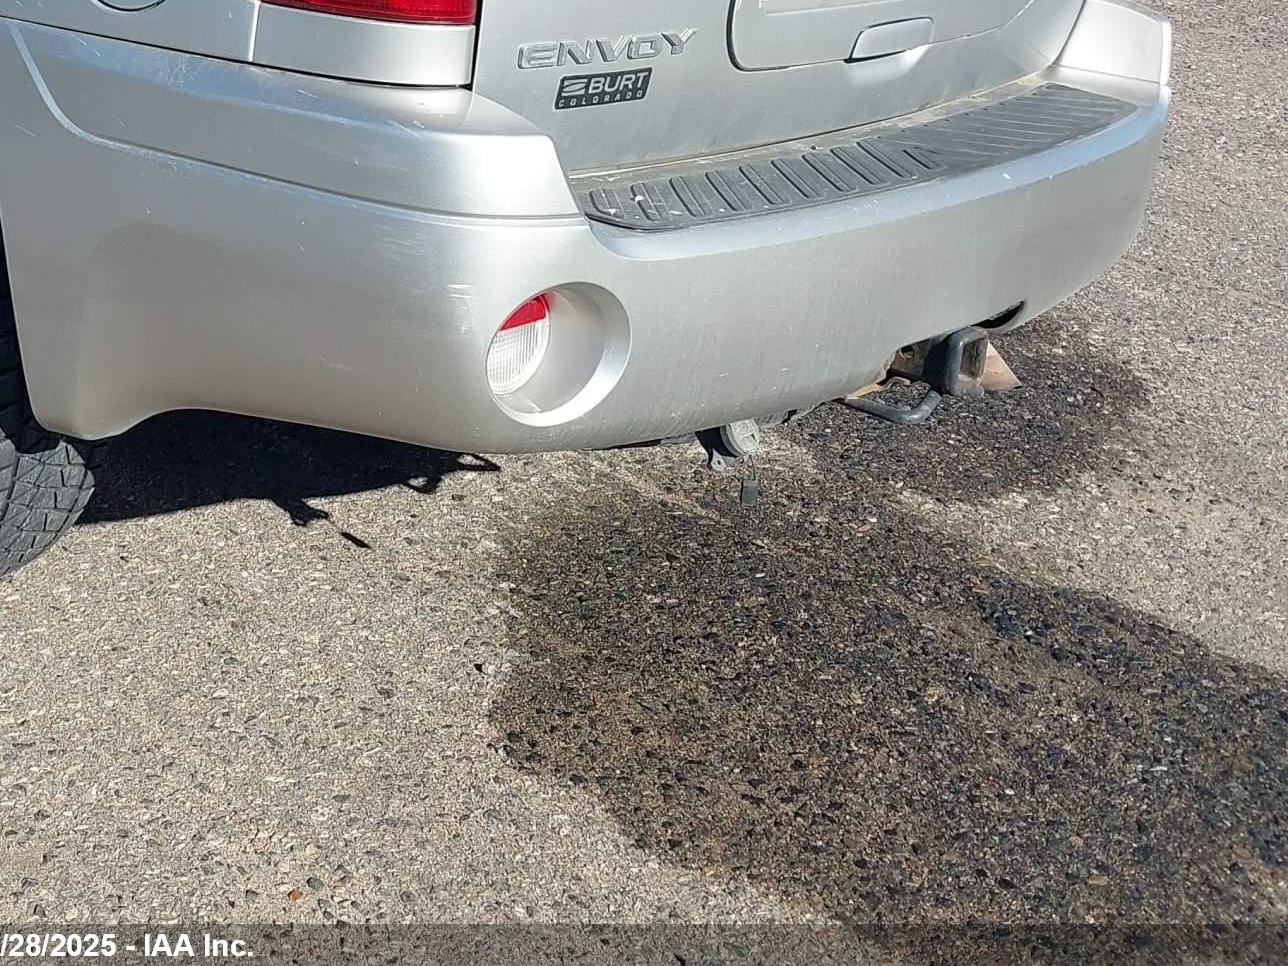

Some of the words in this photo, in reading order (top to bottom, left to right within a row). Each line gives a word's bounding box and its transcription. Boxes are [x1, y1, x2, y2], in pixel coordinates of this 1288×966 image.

[517, 28, 698, 69] ENVOY
[589, 73, 649, 94] BURT
[557, 89, 643, 108] COLORADO
